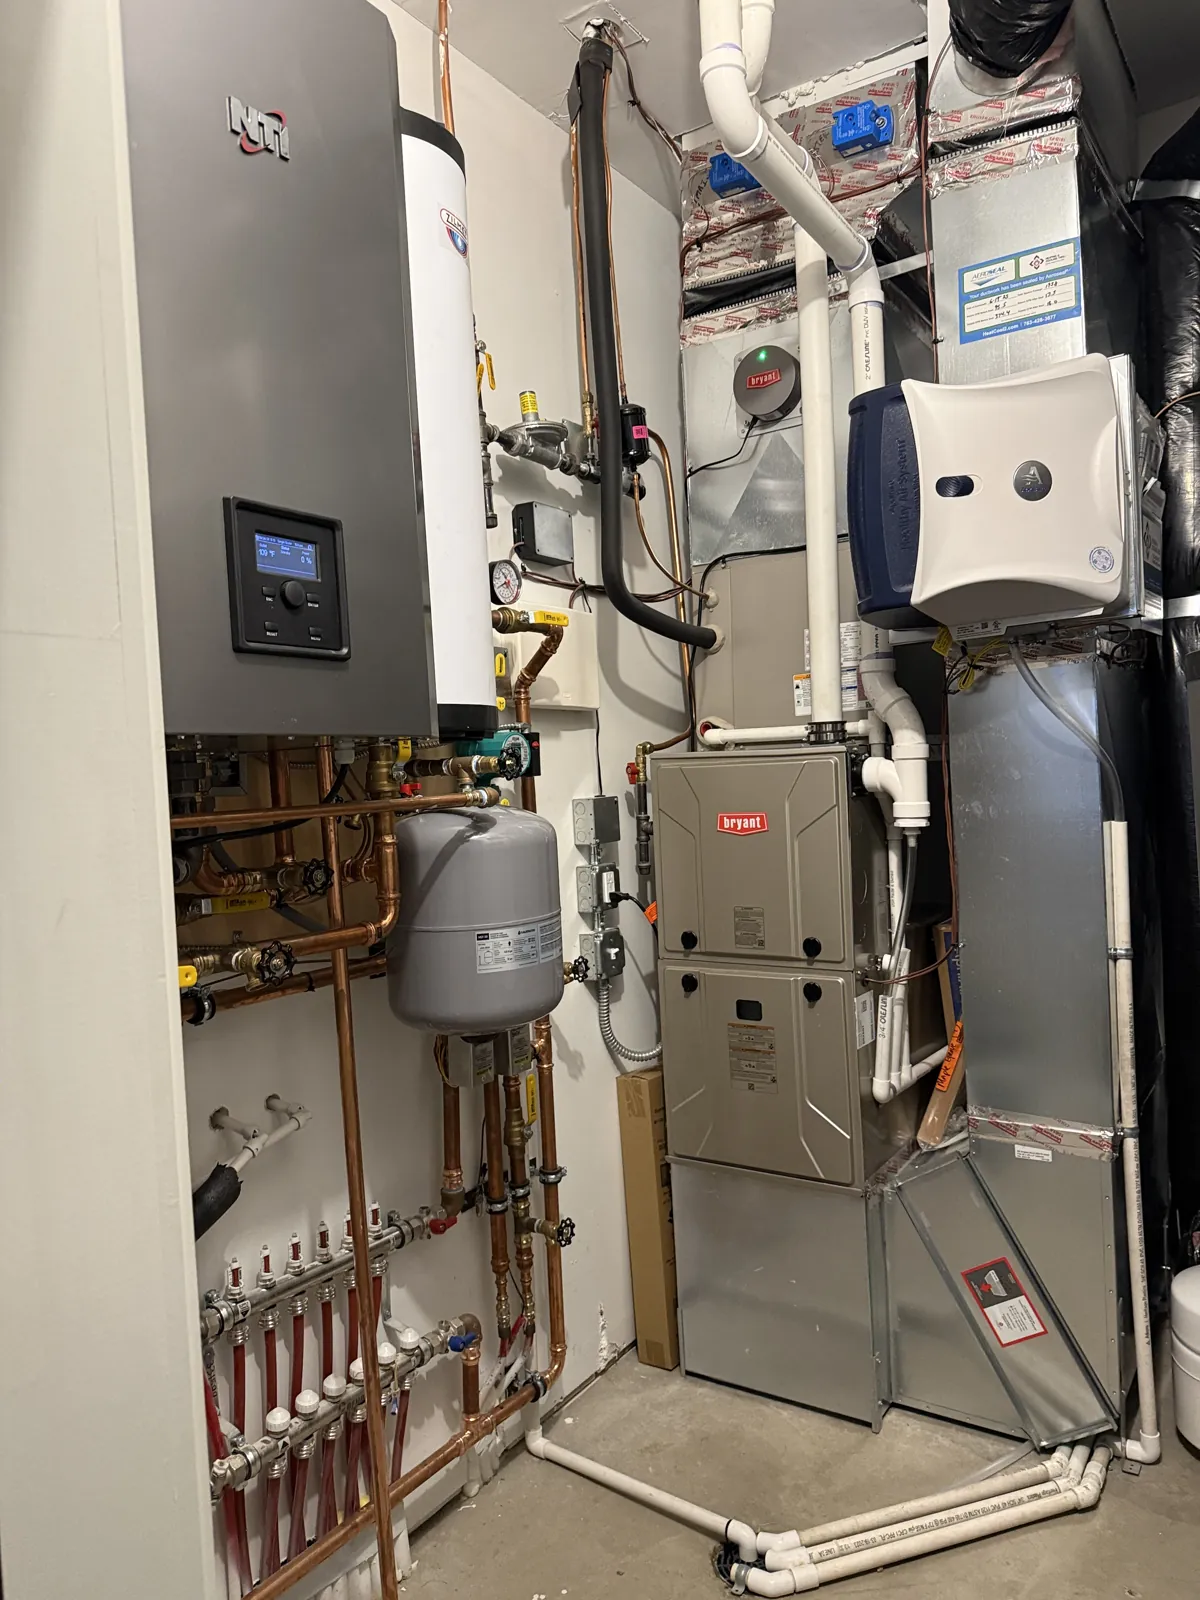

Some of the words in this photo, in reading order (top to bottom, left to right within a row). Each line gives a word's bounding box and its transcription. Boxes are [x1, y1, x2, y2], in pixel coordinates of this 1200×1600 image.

[226, 95, 290, 161] NTI
[972, 265, 1005, 280] AEROSEAL
[980, 287, 1000, 297] ductwork
[1022, 277, 1038, 286] sealed
[751, 371, 776, 386] bryant
[723, 816, 761, 830] bryant
[935, 1064, 952, 1088] Maple
